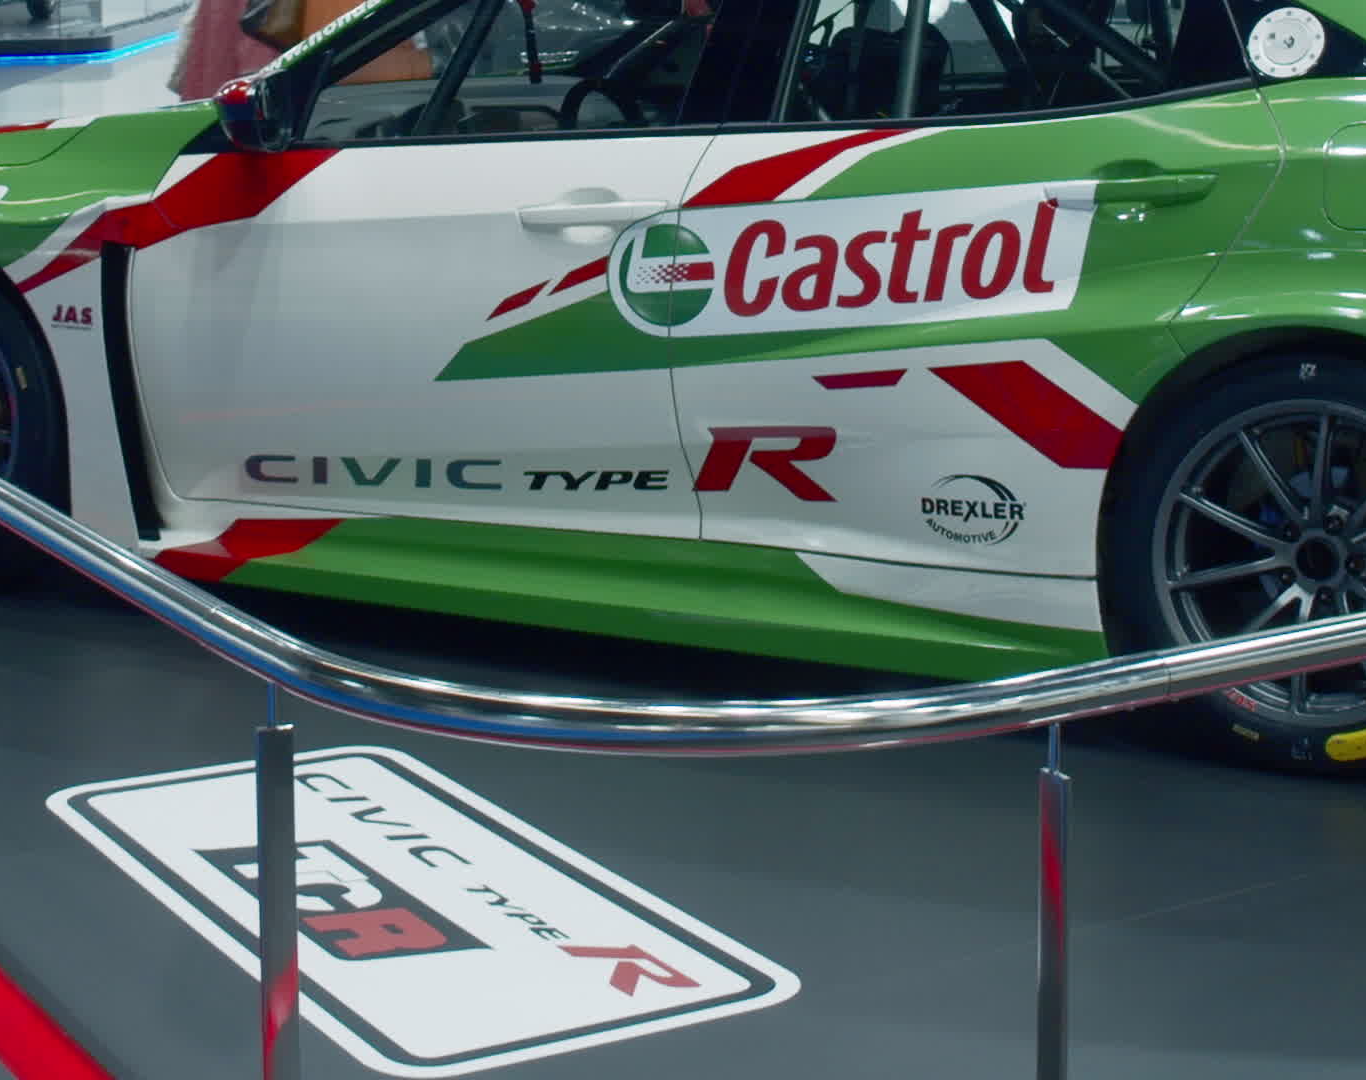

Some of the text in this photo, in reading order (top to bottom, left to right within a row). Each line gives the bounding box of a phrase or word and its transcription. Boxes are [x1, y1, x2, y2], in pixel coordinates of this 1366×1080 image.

[724, 197, 1058, 319] Castrol
[52, 305, 93, 325] JAS
[245, 425, 838, 502] CIVIC TYPE R
[921, 497, 1025, 522] DREXLER
[925, 518, 997, 544] AUTOMOTIVE
[295, 773, 701, 997] CIVIC TYPE R
